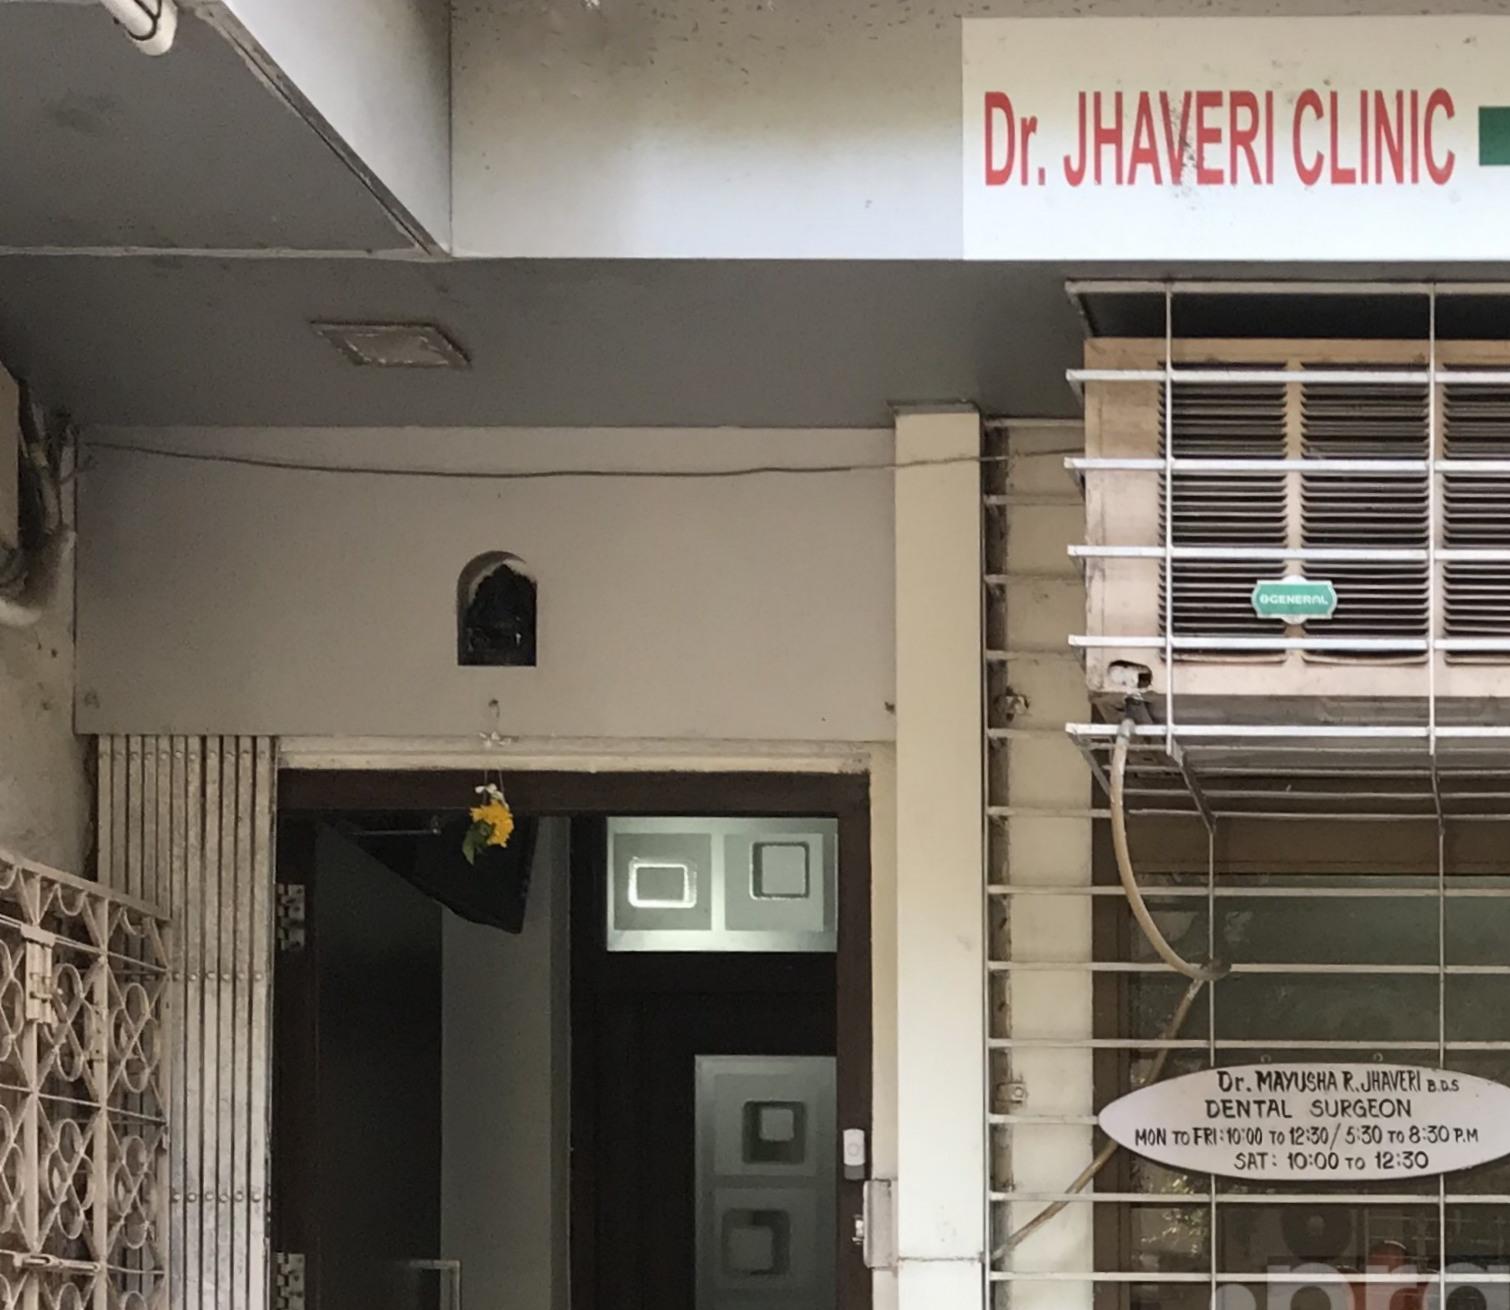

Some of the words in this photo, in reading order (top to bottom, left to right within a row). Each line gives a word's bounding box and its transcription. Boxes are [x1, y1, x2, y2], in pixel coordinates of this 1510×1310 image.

[984, 91, 1046, 186] Dr.
[1063, 90, 1275, 187] JHAVERI
[1293, 87, 1456, 187] CLINIC
[1216, 1070, 1252, 1093] Dr.
[1254, 1070, 1338, 1093] MAYUSHA
[1205, 1099, 1293, 1119] DENTAL
[1309, 1098, 1412, 1118] SURGEON
[1134, 1127, 1167, 1146] MON
[1172, 1130, 1190, 1146] TO
[1269, 1130, 1285, 1145] TO
[1345, 1124, 1383, 1145] 5:30
[1387, 1130, 1405, 1143] TO
[1408, 1124, 1450, 1144] 8:30
[1233, 1151, 1278, 1170] SAT:
[1287, 1151, 1340, 1171] 10:00
[1345, 1157, 1366, 1170] TO
[1375, 1151, 1429, 1170] 12:30
